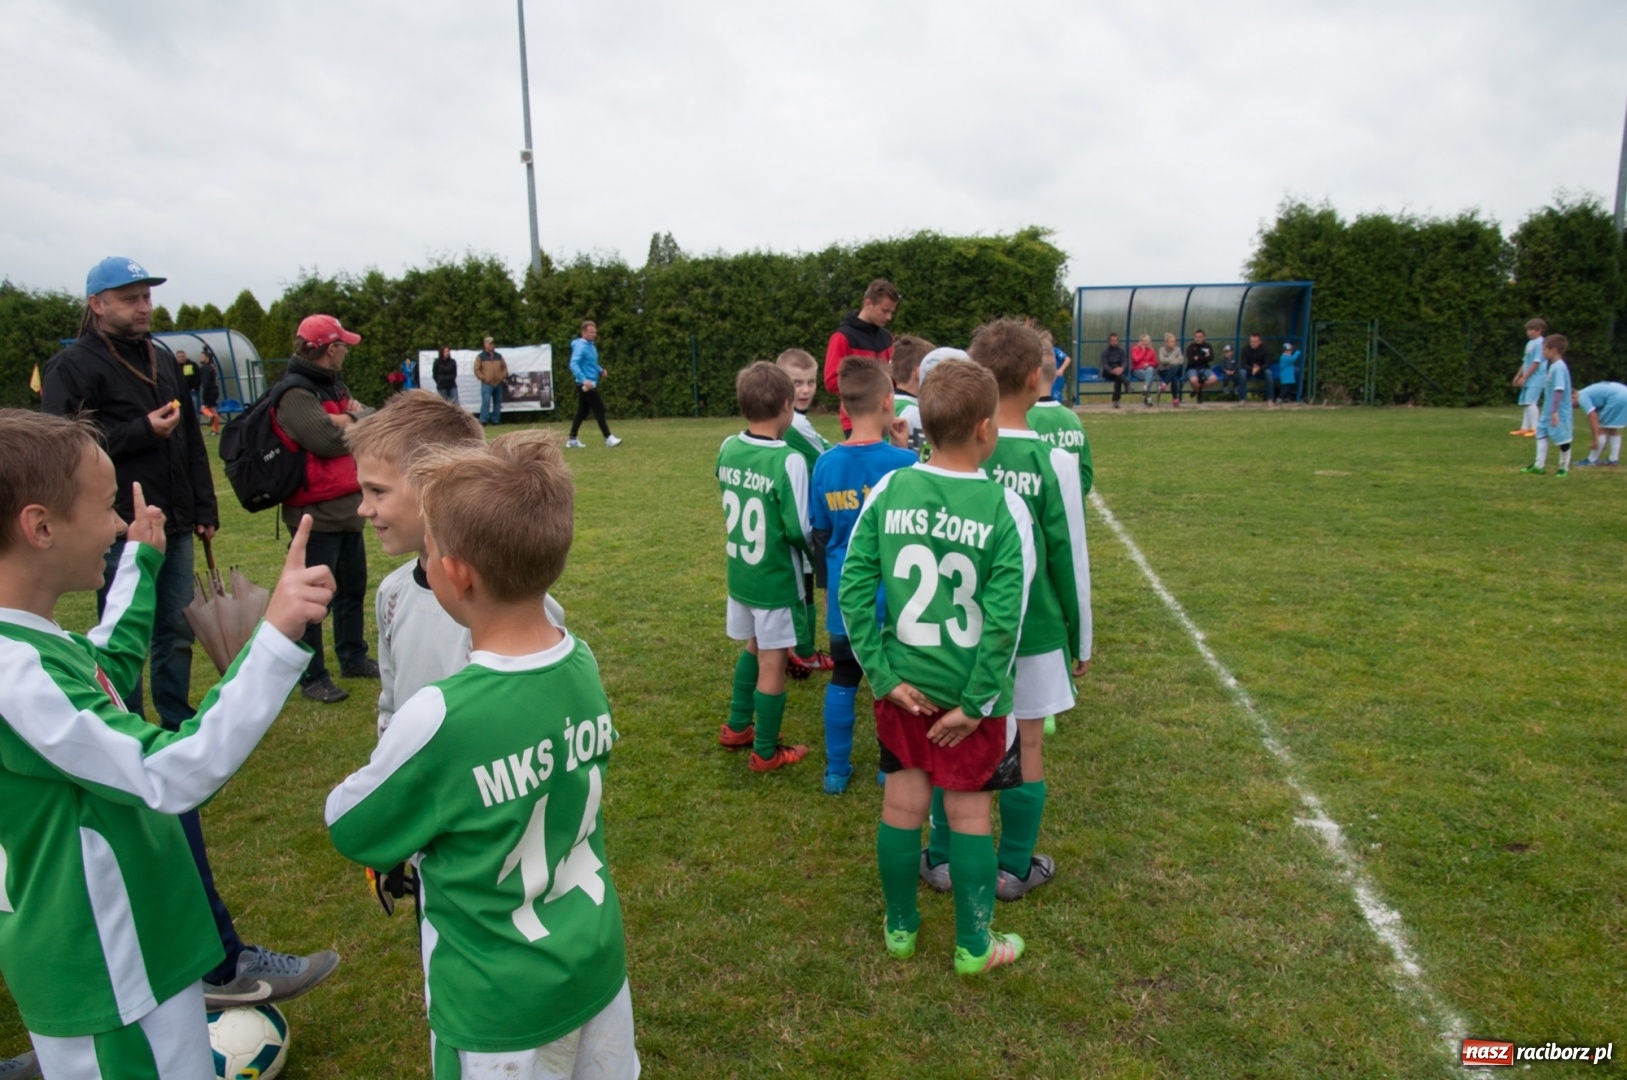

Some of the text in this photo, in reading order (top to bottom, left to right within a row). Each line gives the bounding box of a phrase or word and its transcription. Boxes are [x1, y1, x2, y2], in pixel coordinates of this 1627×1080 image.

[1058, 427, 1084, 448] ŻORY
[718, 465, 774, 494] MKS ŻORY
[993, 463, 1042, 496] ŻORY
[722, 489, 766, 566] 29
[884, 506, 994, 549] MKS ŻORY
[893, 543, 984, 648] 23
[472, 712, 613, 808] MKS ŻOR
[497, 763, 606, 943] 14
